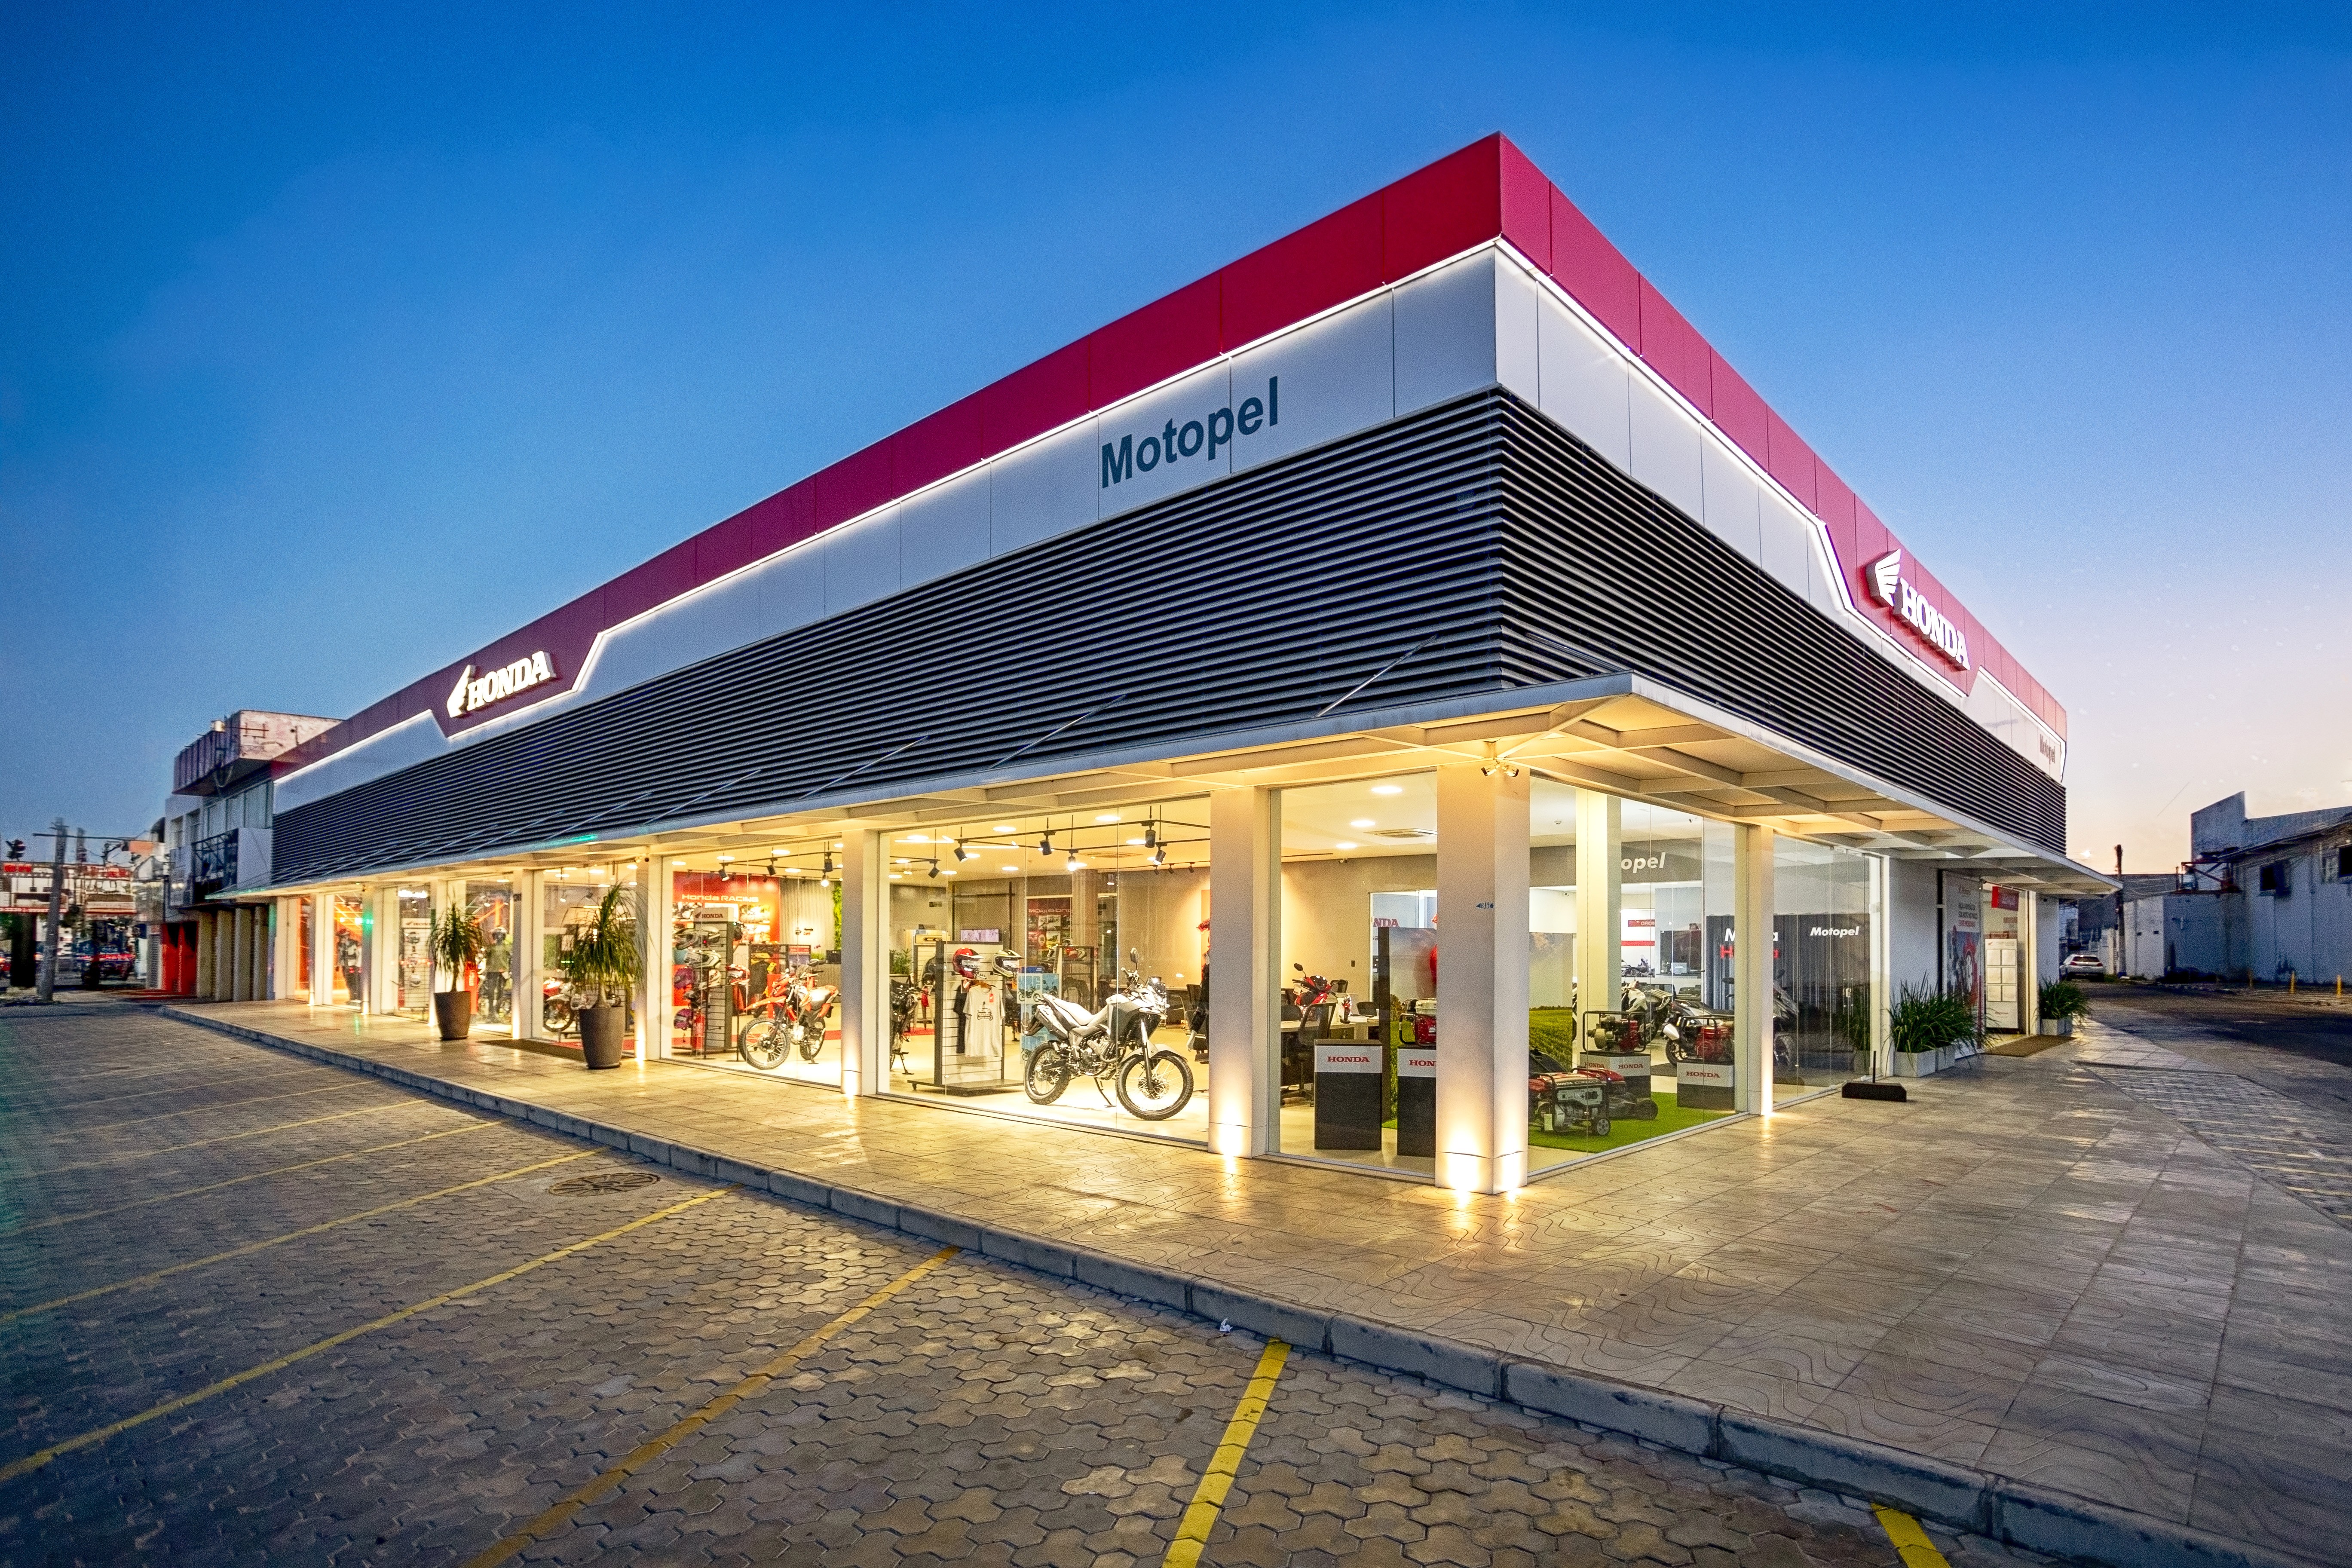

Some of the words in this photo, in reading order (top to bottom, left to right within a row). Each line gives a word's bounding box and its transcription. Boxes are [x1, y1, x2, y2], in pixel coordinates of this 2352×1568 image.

[1102, 376, 1278, 488] Motopel
[1900, 578, 1970, 670] HONDA
[467, 650, 551, 710] HONDA
[1621, 852, 1666, 873] opel
[1373, 918, 1400, 927] NDA
[1810, 926, 1860, 938] Motopel
